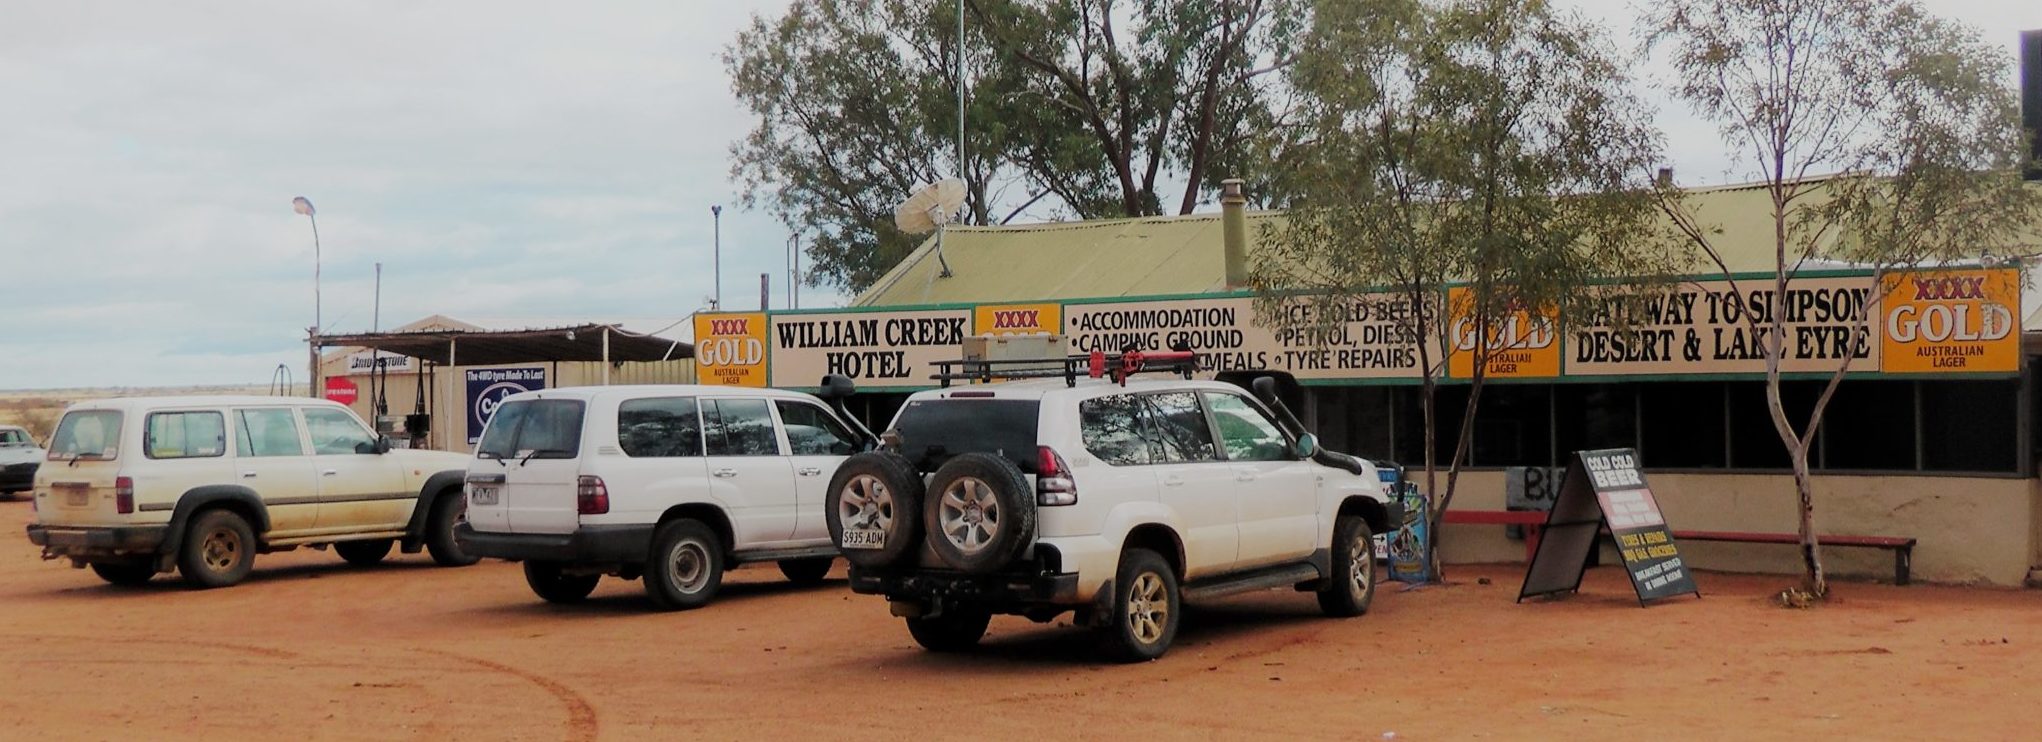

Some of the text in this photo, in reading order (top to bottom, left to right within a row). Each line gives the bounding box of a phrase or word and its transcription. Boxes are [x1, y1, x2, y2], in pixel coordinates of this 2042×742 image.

[1914, 277, 1984, 300] XXXX
[1321, 302, 1369, 323] OLD
[1705, 291, 1743, 324] TO
[1749, 288, 1869, 324] SIMPSON
[711, 320, 748, 335] XXXX
[994, 311, 1039, 328] XXXX
[1080, 307, 1235, 331] ACCOMMODATION
[1888, 303, 2012, 342] GOLD
[777, 318, 966, 348] WILLIAM CREEK
[1079, 330, 1243, 352] CAMPING GROUND
[1452, 315, 1554, 351] GOLD
[698, 338, 763, 366] GOLD
[1577, 329, 1675, 363] DESERT
[1683, 328, 1702, 361] &
[1796, 326, 1870, 359] EYRE
[1916, 346, 1984, 357] AUSTRALIAN
[827, 351, 911, 379] HOTEL
[1205, 351, 1267, 370] MEALS
[1284, 348, 1416, 370] TYRE REPAIRS
[1490, 364, 1517, 373] LAGER
[1933, 357, 1966, 367] LAGER
[468, 371, 478, 380] The
[479, 371, 492, 380] 4WD
[506, 371, 522, 380] Made
[523, 371, 531, 379] To
[531, 370, 544, 379] Last
[714, 368, 749, 376] AUSTRALIAN
[1587, 454, 1635, 471] COLD COLD
[1592, 468, 1642, 487] BEER
[843, 531, 863, 544] S935
